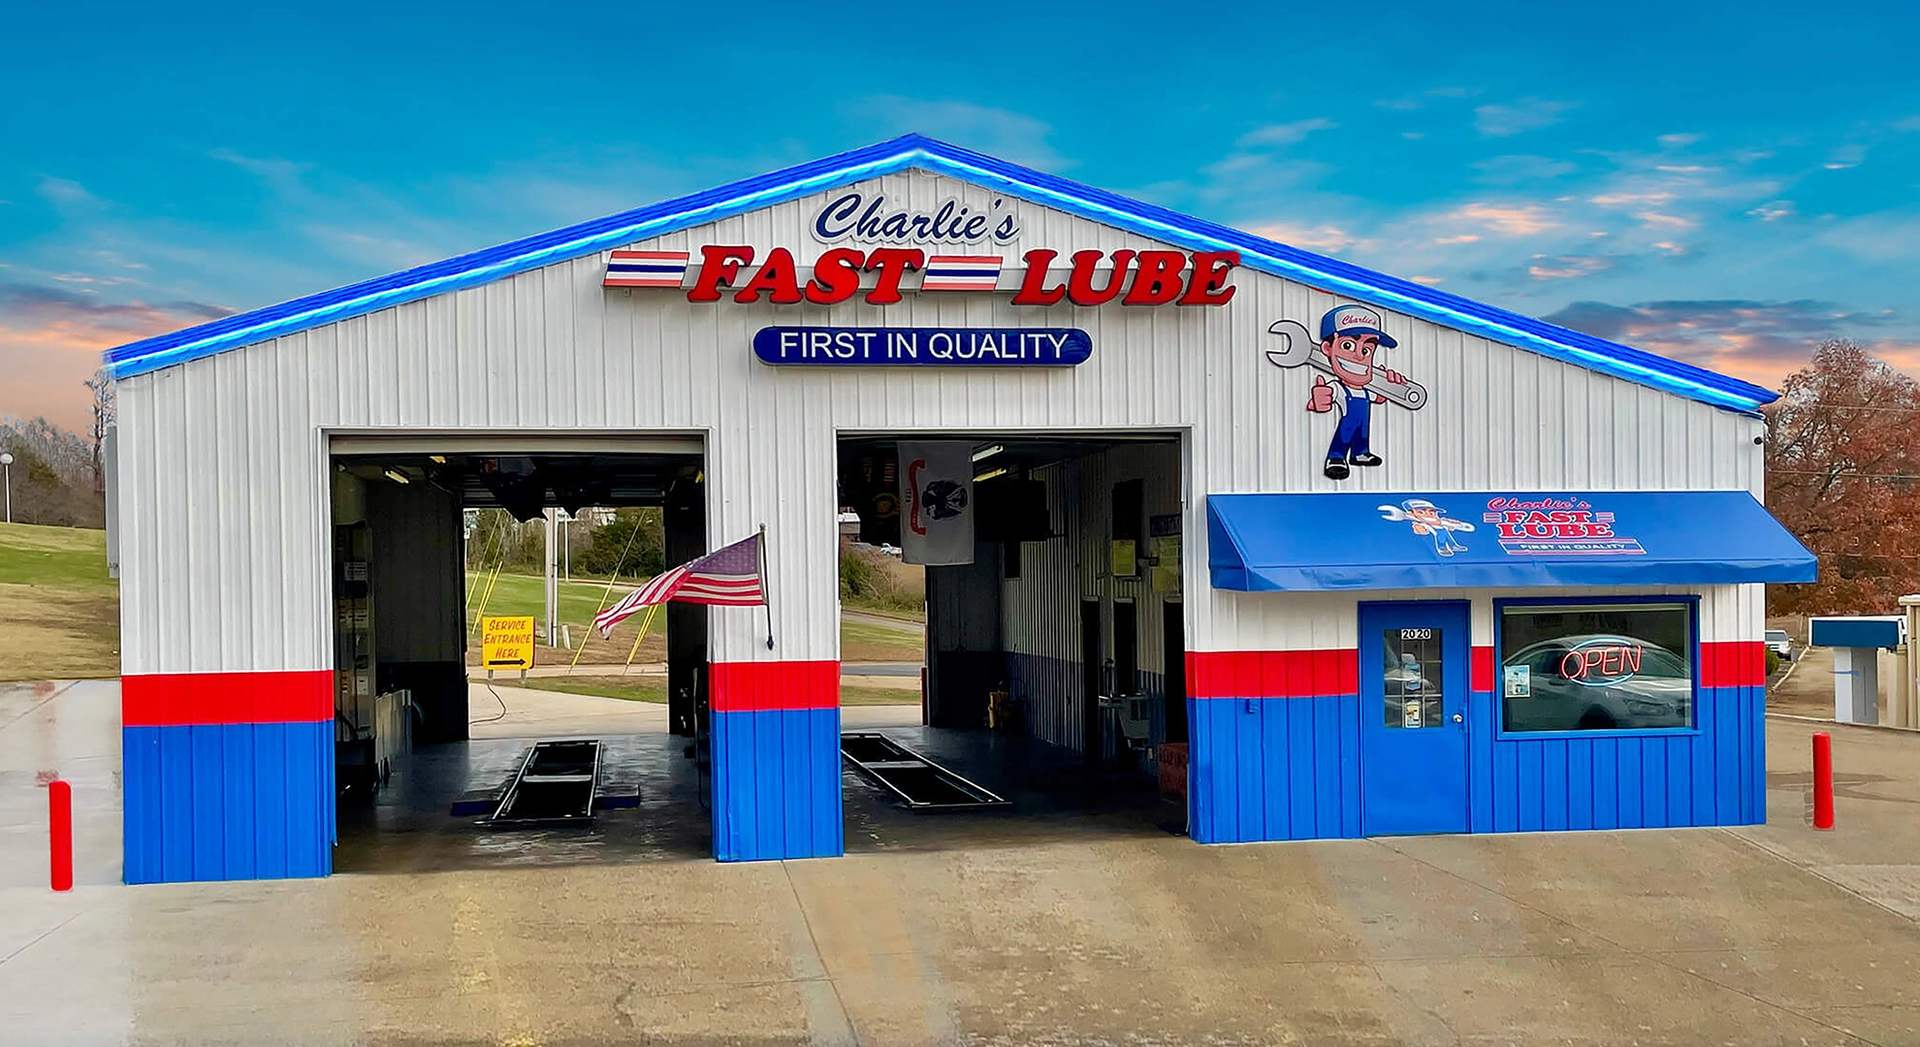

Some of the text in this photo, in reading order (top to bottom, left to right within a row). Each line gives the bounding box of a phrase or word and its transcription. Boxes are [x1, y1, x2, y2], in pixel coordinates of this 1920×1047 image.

[813, 193, 1018, 242] Charlie's
[688, 245, 1241, 306] FAST LUBE
[779, 331, 1070, 361] FIRST IN QUALITY
[1487, 497, 1592, 510] Charlie's
[1504, 511, 1593, 523] FAST
[1497, 523, 1614, 538] LUBE
[489, 620, 526, 631] SERVICE
[484, 633, 532, 645] ENTRANCE
[1403, 629, 1430, 639] 2020
[496, 647, 520, 659] HERE
[1561, 644, 1642, 679] OPEN
